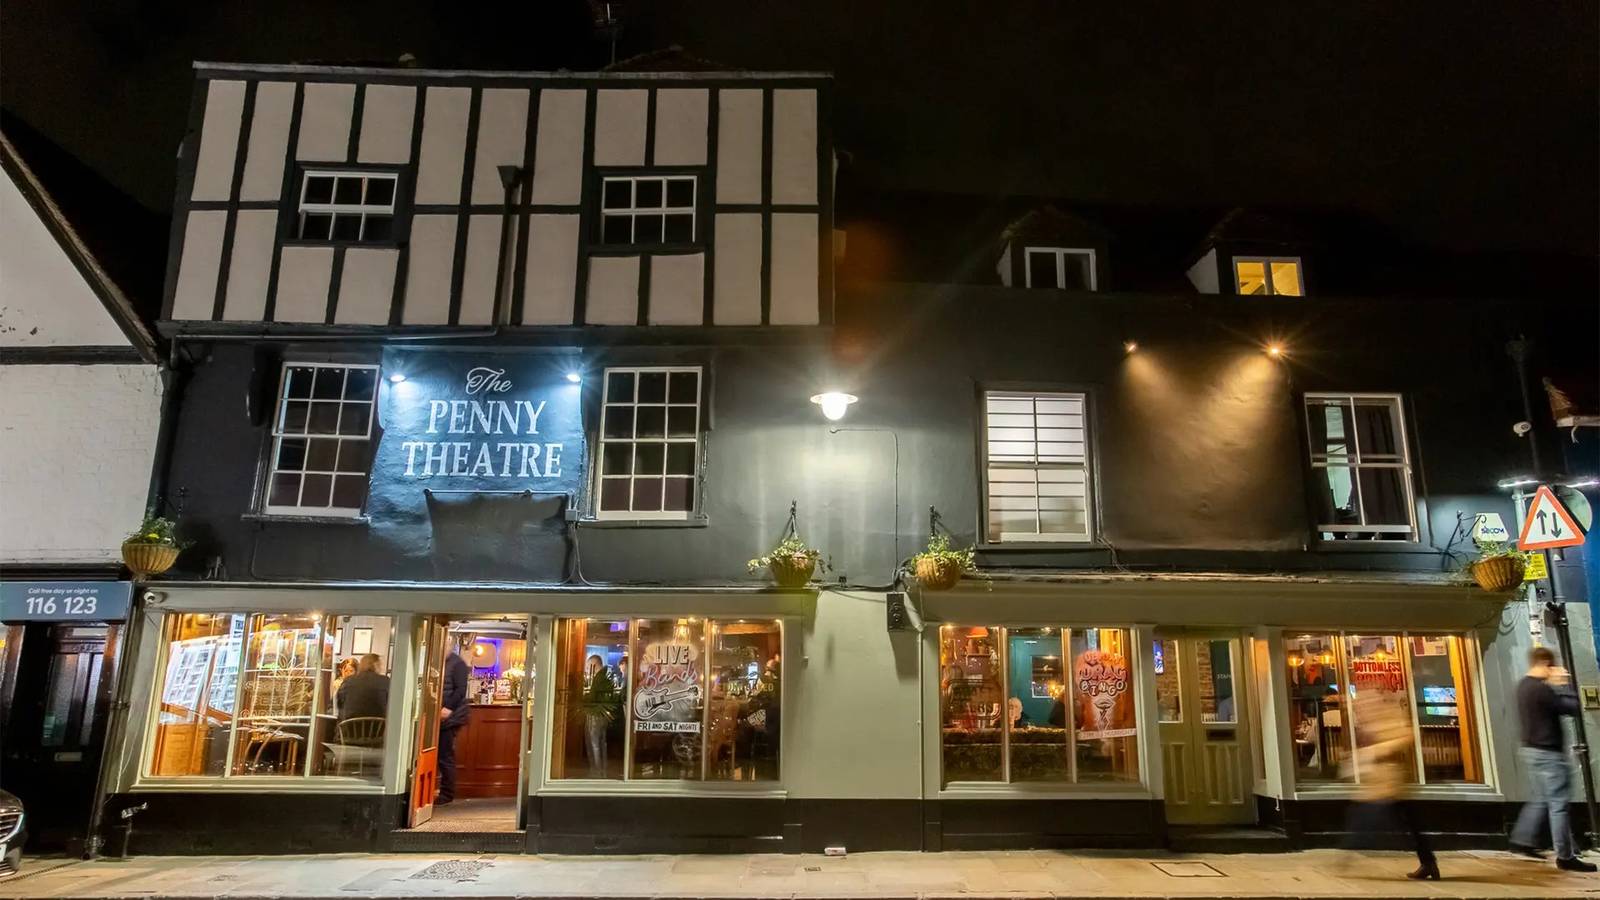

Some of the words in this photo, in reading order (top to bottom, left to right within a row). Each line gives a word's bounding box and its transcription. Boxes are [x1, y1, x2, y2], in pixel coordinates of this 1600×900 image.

[465, 366, 513, 395] The
[425, 400, 547, 435] PENNY
[401, 441, 564, 478] THEATRE
[53, 588, 65, 596] day
[73, 588, 90, 596] night
[26, 596, 57, 615] 116
[63, 596, 97, 615] 123
[655, 645, 690, 665] LIVE
[1080, 680, 1126, 696] BINGO
[637, 722, 651, 731] FRI
[663, 722, 678, 731] SAT
